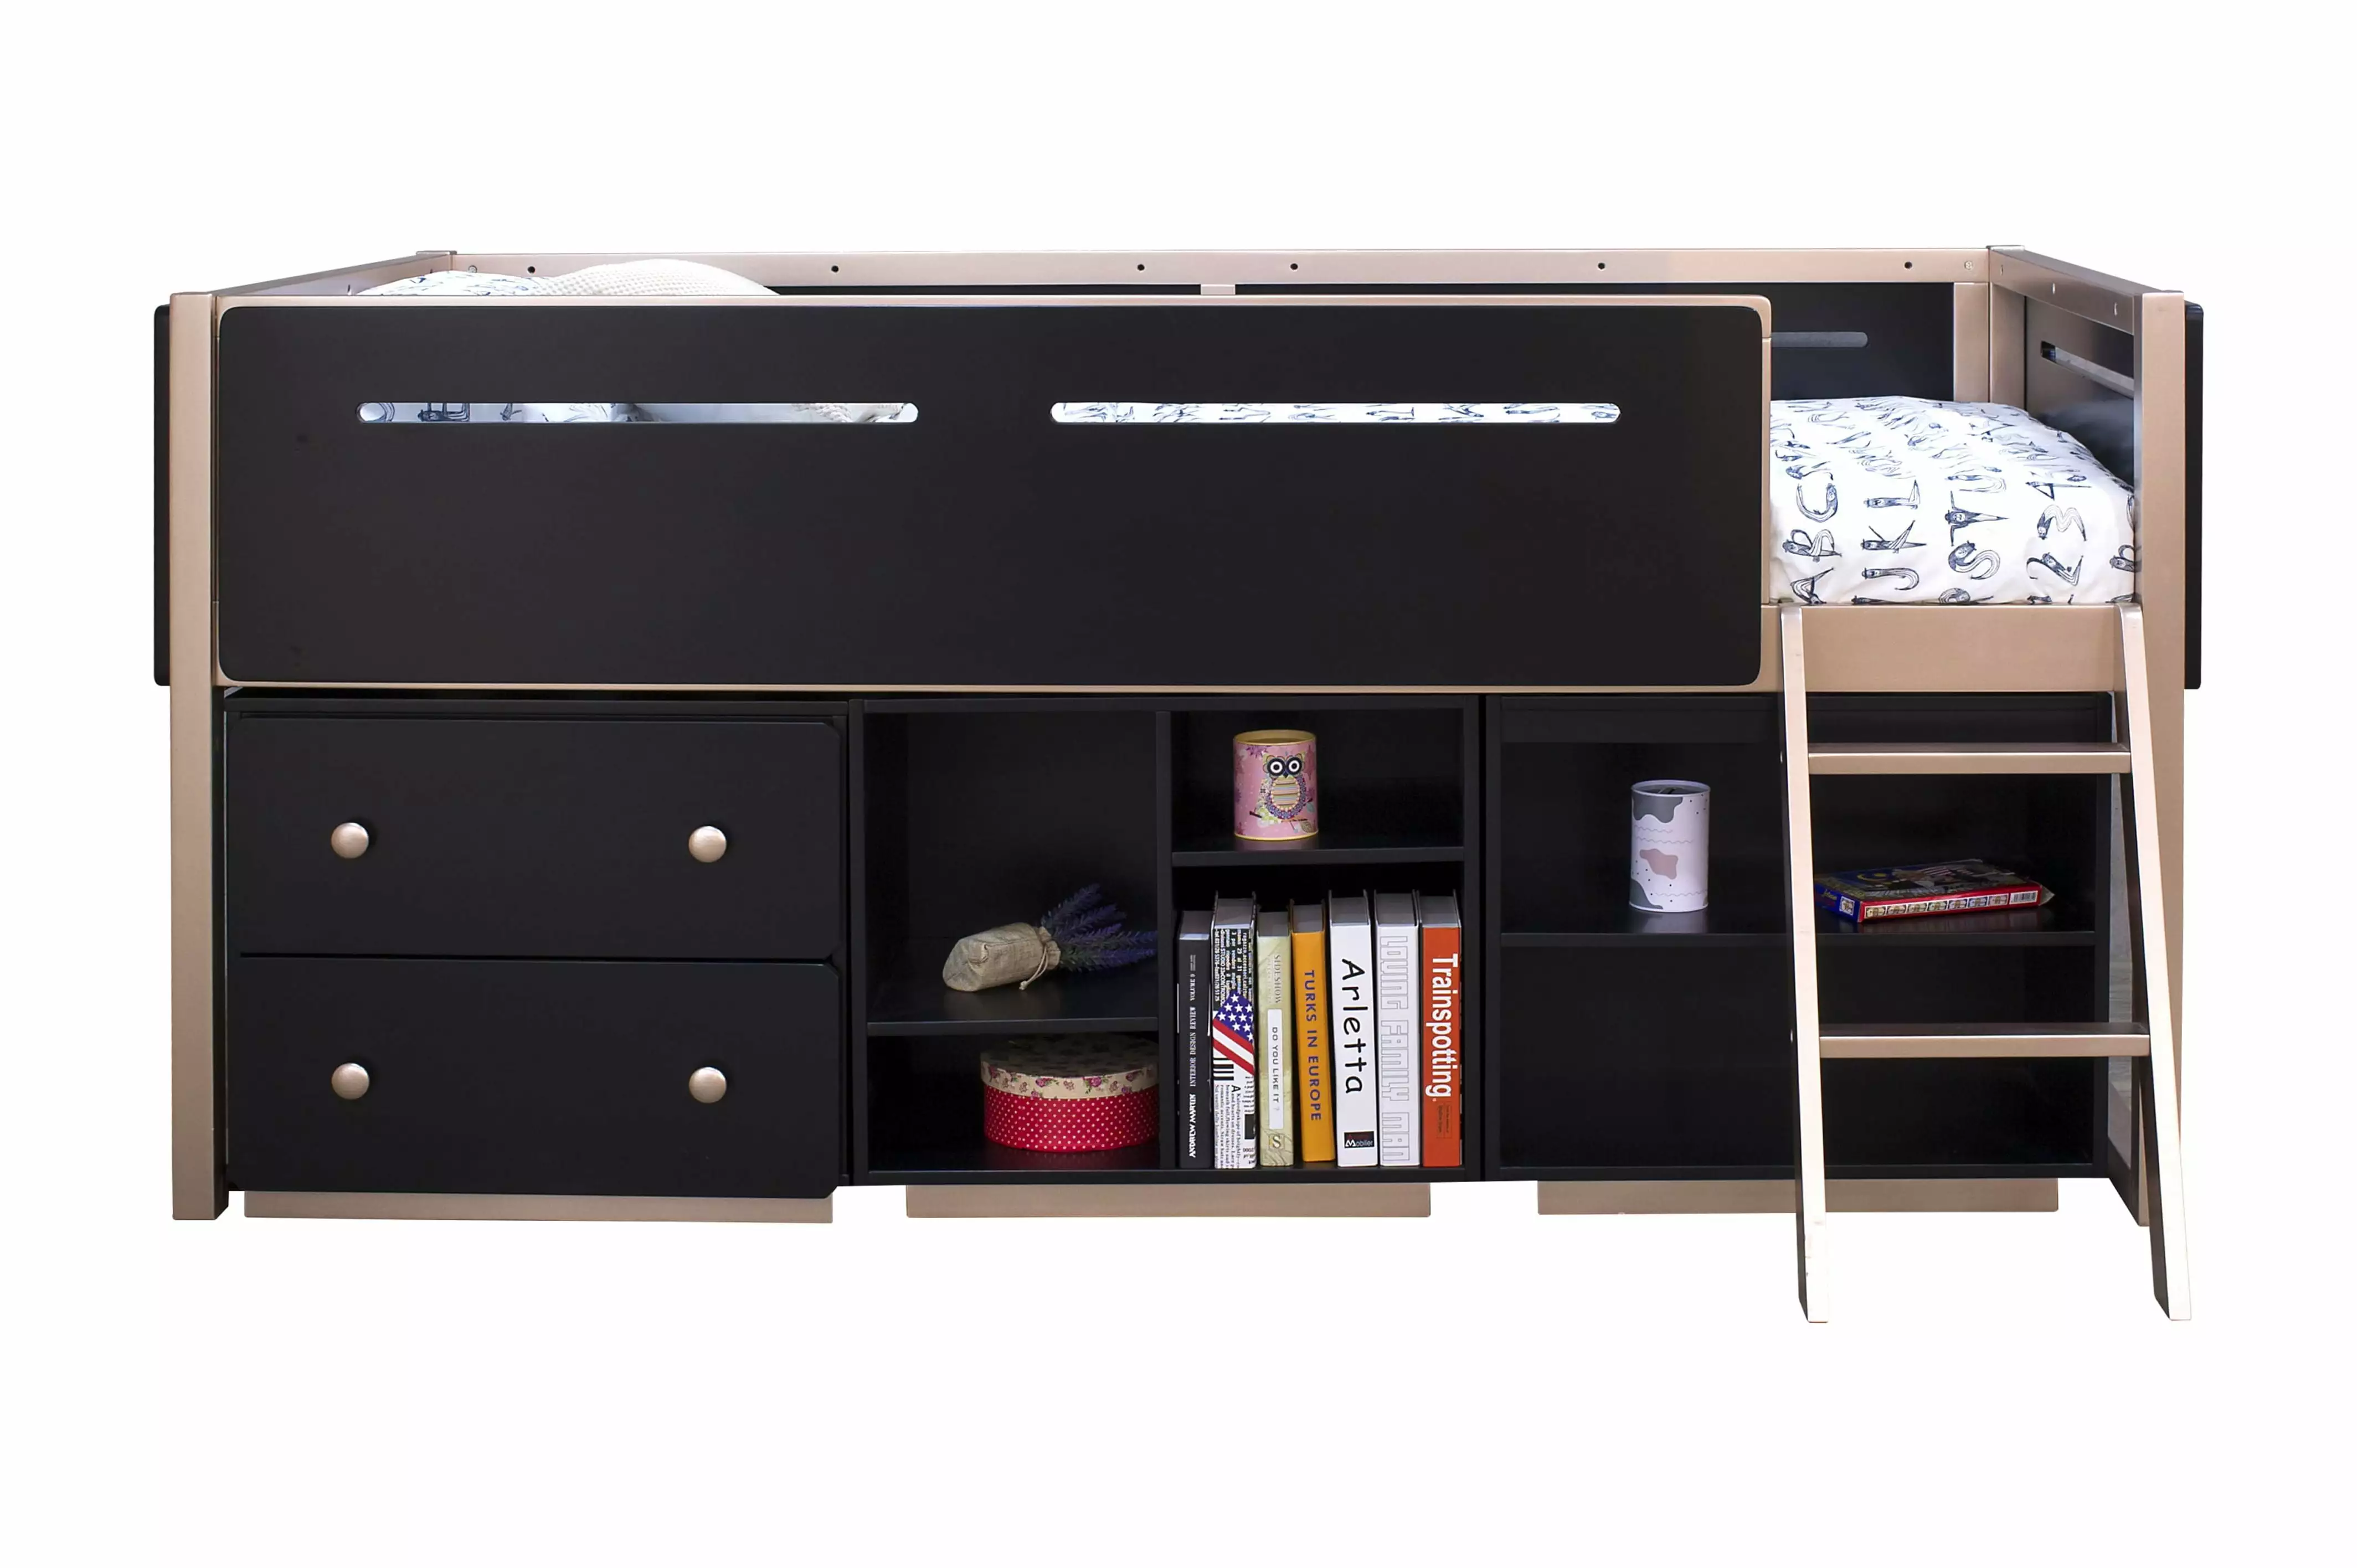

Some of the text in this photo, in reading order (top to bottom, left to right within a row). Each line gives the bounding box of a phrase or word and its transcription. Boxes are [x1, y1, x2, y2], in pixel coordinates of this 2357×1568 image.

[1272, 1027, 1278, 1041] DO
[1304, 969, 1322, 1121] TURKS IN EUROPE
[1341, 958, 1368, 1094] Arletta
[1380, 936, 1410, 1161] LOVING FAMILY MAN
[1273, 1094, 1279, 1103] IT
